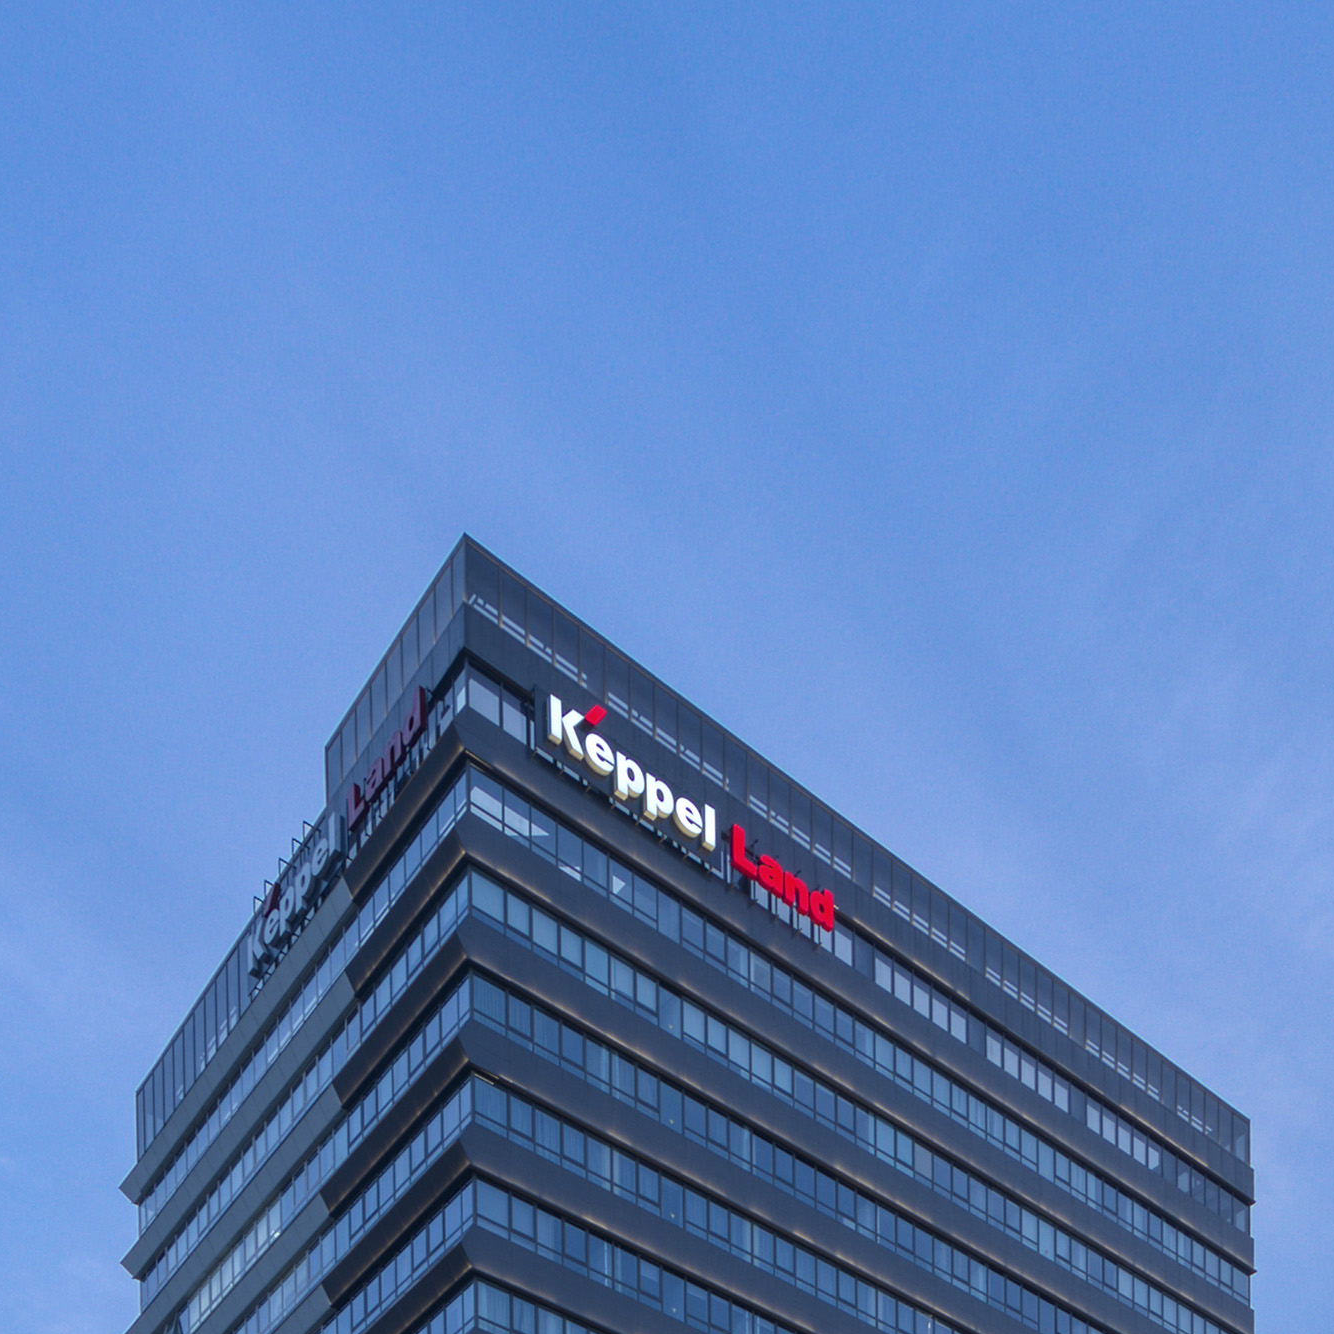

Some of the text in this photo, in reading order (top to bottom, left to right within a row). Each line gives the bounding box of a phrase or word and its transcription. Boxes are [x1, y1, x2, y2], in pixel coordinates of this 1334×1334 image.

[247, 685, 427, 979] Keppel Land
[548, 694, 835, 933] Keppel Land
